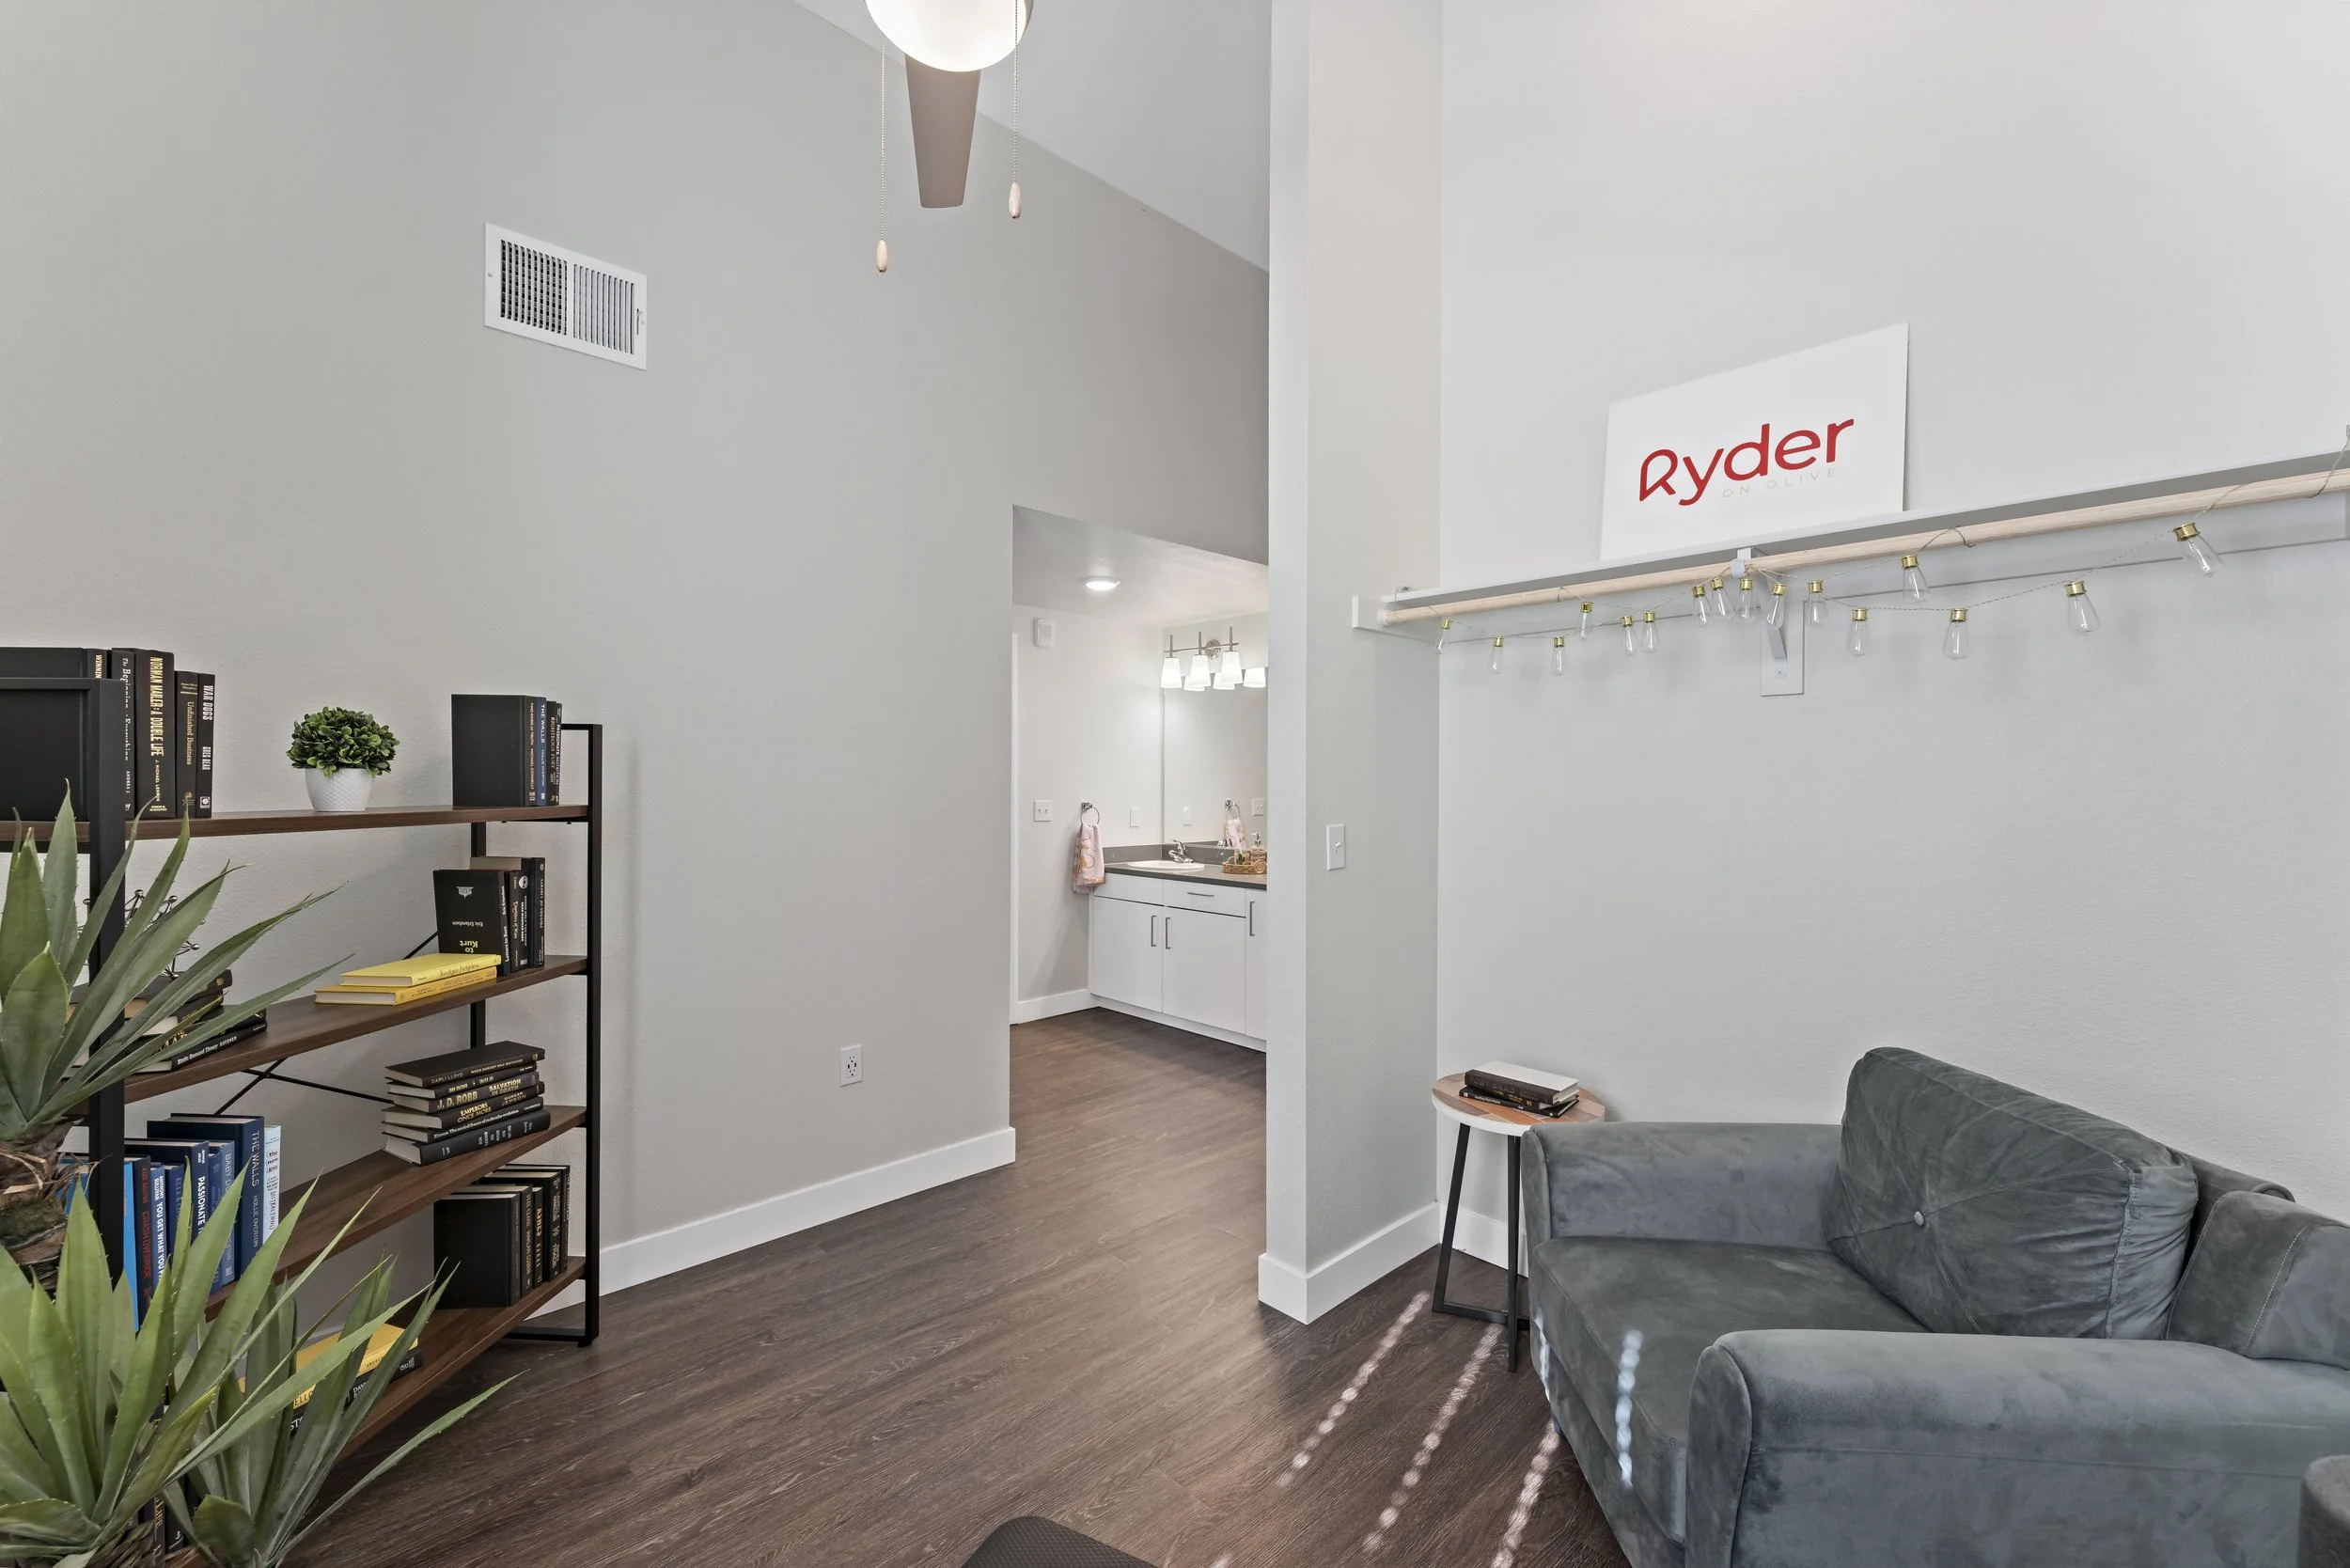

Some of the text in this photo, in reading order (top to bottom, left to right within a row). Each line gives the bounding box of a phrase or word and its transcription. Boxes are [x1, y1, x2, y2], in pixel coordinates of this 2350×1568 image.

[1639, 418, 1855, 506] Ryder
[1722, 467, 1837, 498] ON OLIVE
[150, 656, 163, 683] NORMAN
[202, 685, 214, 720] WAR DOGS
[150, 717, 164, 742] DOUBLE
[150, 743, 164, 756] LIFE
[201, 746, 212, 770] GREG BEAR
[460, 940, 478, 949] Kurt
[177, 1056, 189, 1065] Static
[189, 1048, 205, 1059] Demand
[205, 1043, 218, 1053] Theory
[431, 1072, 463, 1084] CARLI LLOYD
[490, 1078, 521, 1091] SALVATION
[437, 1090, 478, 1109] J. D. ROBB
[460, 1102, 488, 1116] EMPERORS
[458, 1106, 492, 1122] ONCE MORE
[251, 1152, 259, 1187] WALLS
[197, 1176, 206, 1226] PASSIONATE
[142, 1211, 150, 1238] CRASH
